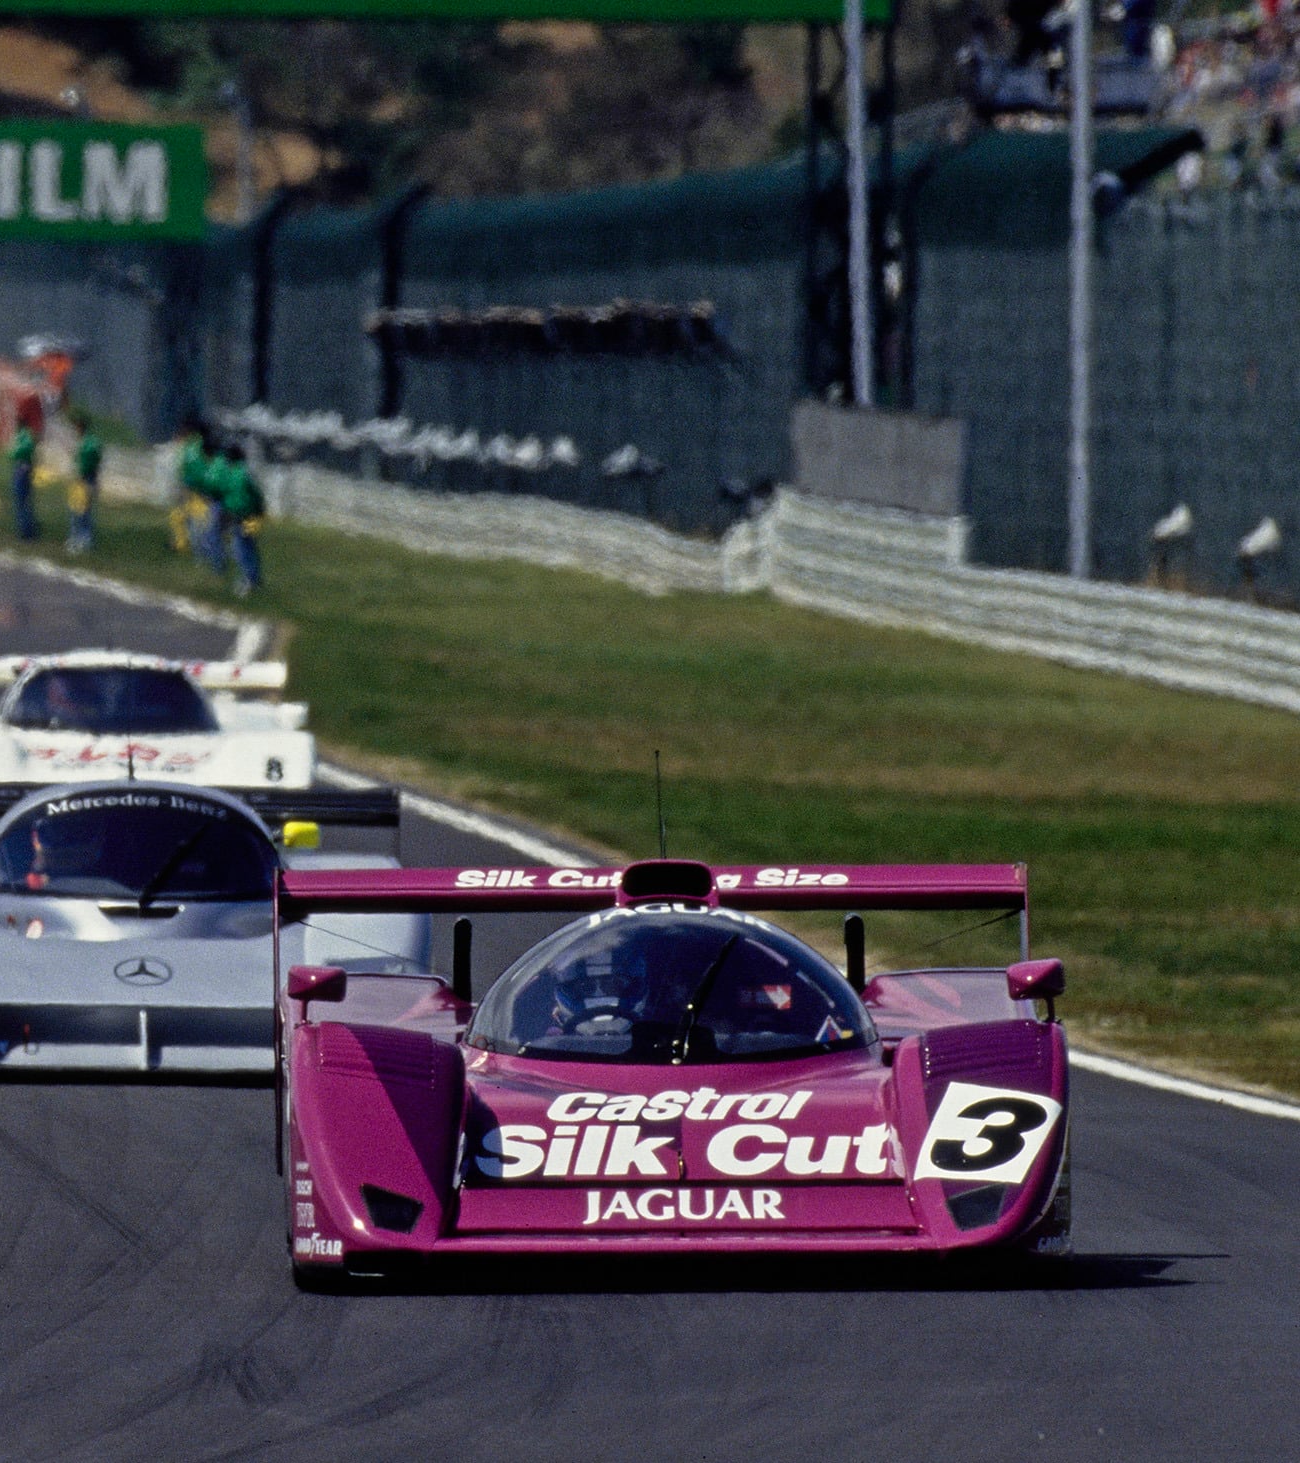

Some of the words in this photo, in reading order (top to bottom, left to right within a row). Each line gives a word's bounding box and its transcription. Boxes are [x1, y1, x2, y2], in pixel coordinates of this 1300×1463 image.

[265, 756, 285, 781] 8
[454, 869, 534, 888] Silk
[547, 869, 622, 888] Cut
[753, 868, 849, 886] Size
[546, 1087, 813, 1122] Castrol
[475, 1125, 675, 1178] Silk
[706, 1122, 892, 1176] Cut
[931, 1098, 1049, 1173] 3
[583, 1189, 785, 1224] JAGUAR
